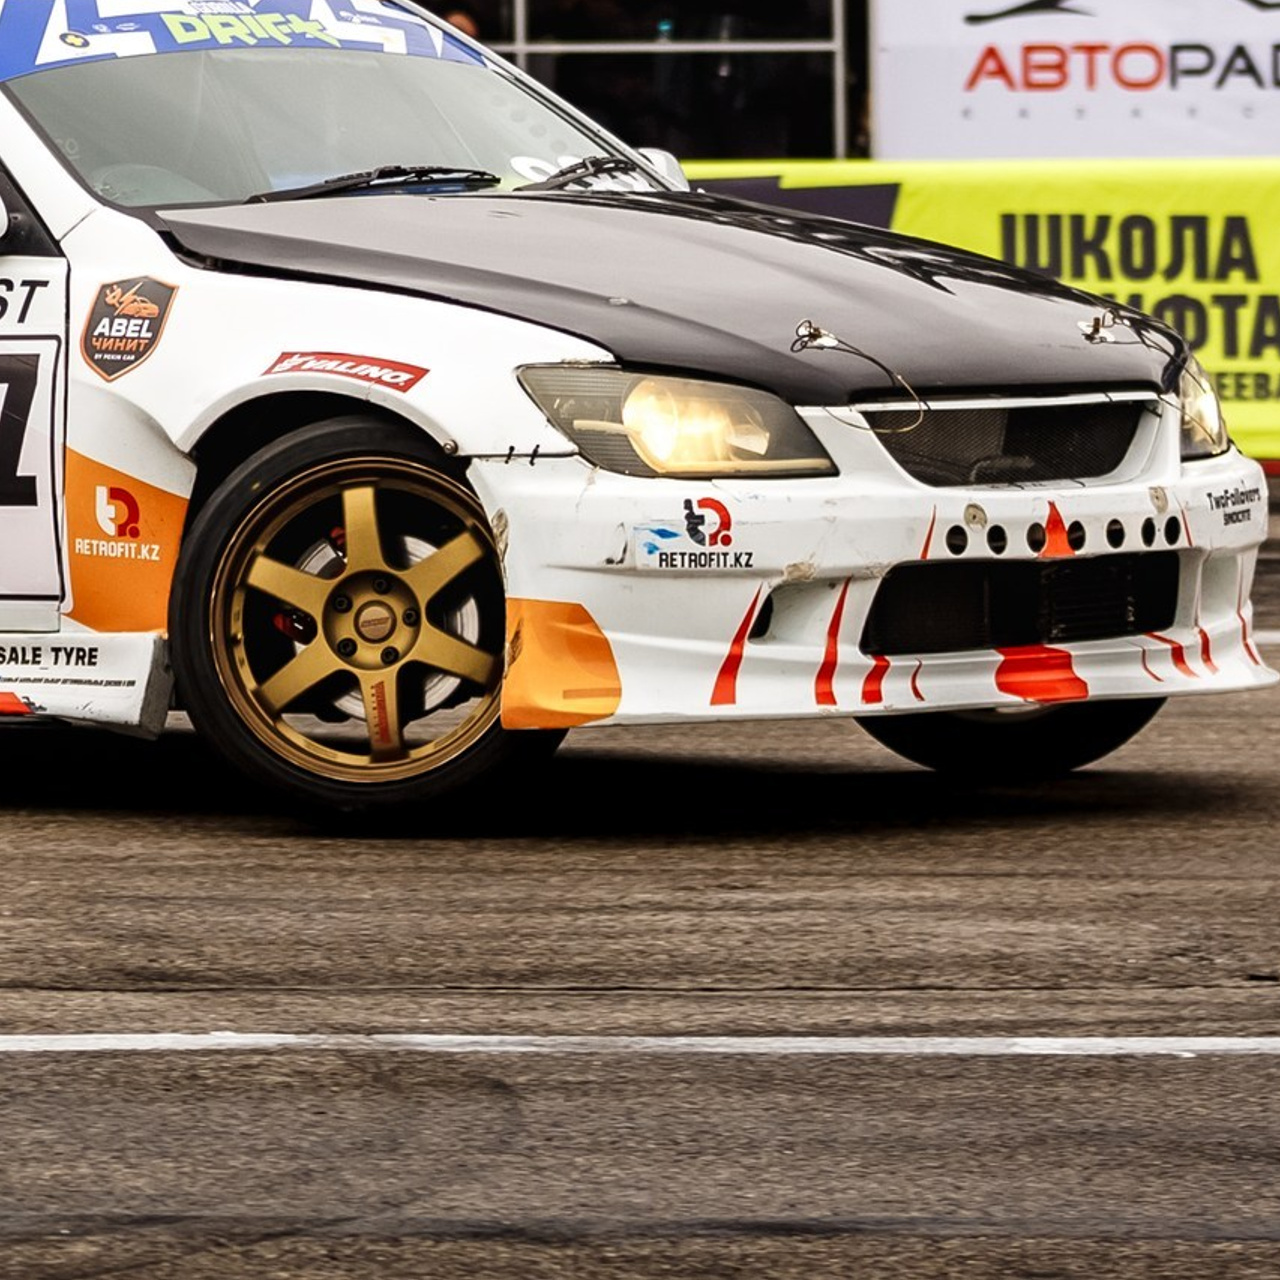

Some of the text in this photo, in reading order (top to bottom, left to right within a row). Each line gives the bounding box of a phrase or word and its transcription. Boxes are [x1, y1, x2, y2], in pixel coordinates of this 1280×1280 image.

[159, 12, 342, 48] DRIFT
[963, 42, 1280, 93] АВТОРА
[1000, 212, 1261, 284] ШКОЛА
[93, 317, 153, 338] ABEL
[1101, 293, 1280, 361] ФТА
[91, 337, 150, 352] ЧИНИТ
[300, 358, 415, 384] VALINO
[75, 539, 160, 561] RETROFIT.KZ
[659, 552, 753, 568] RETROFIT.KZ
